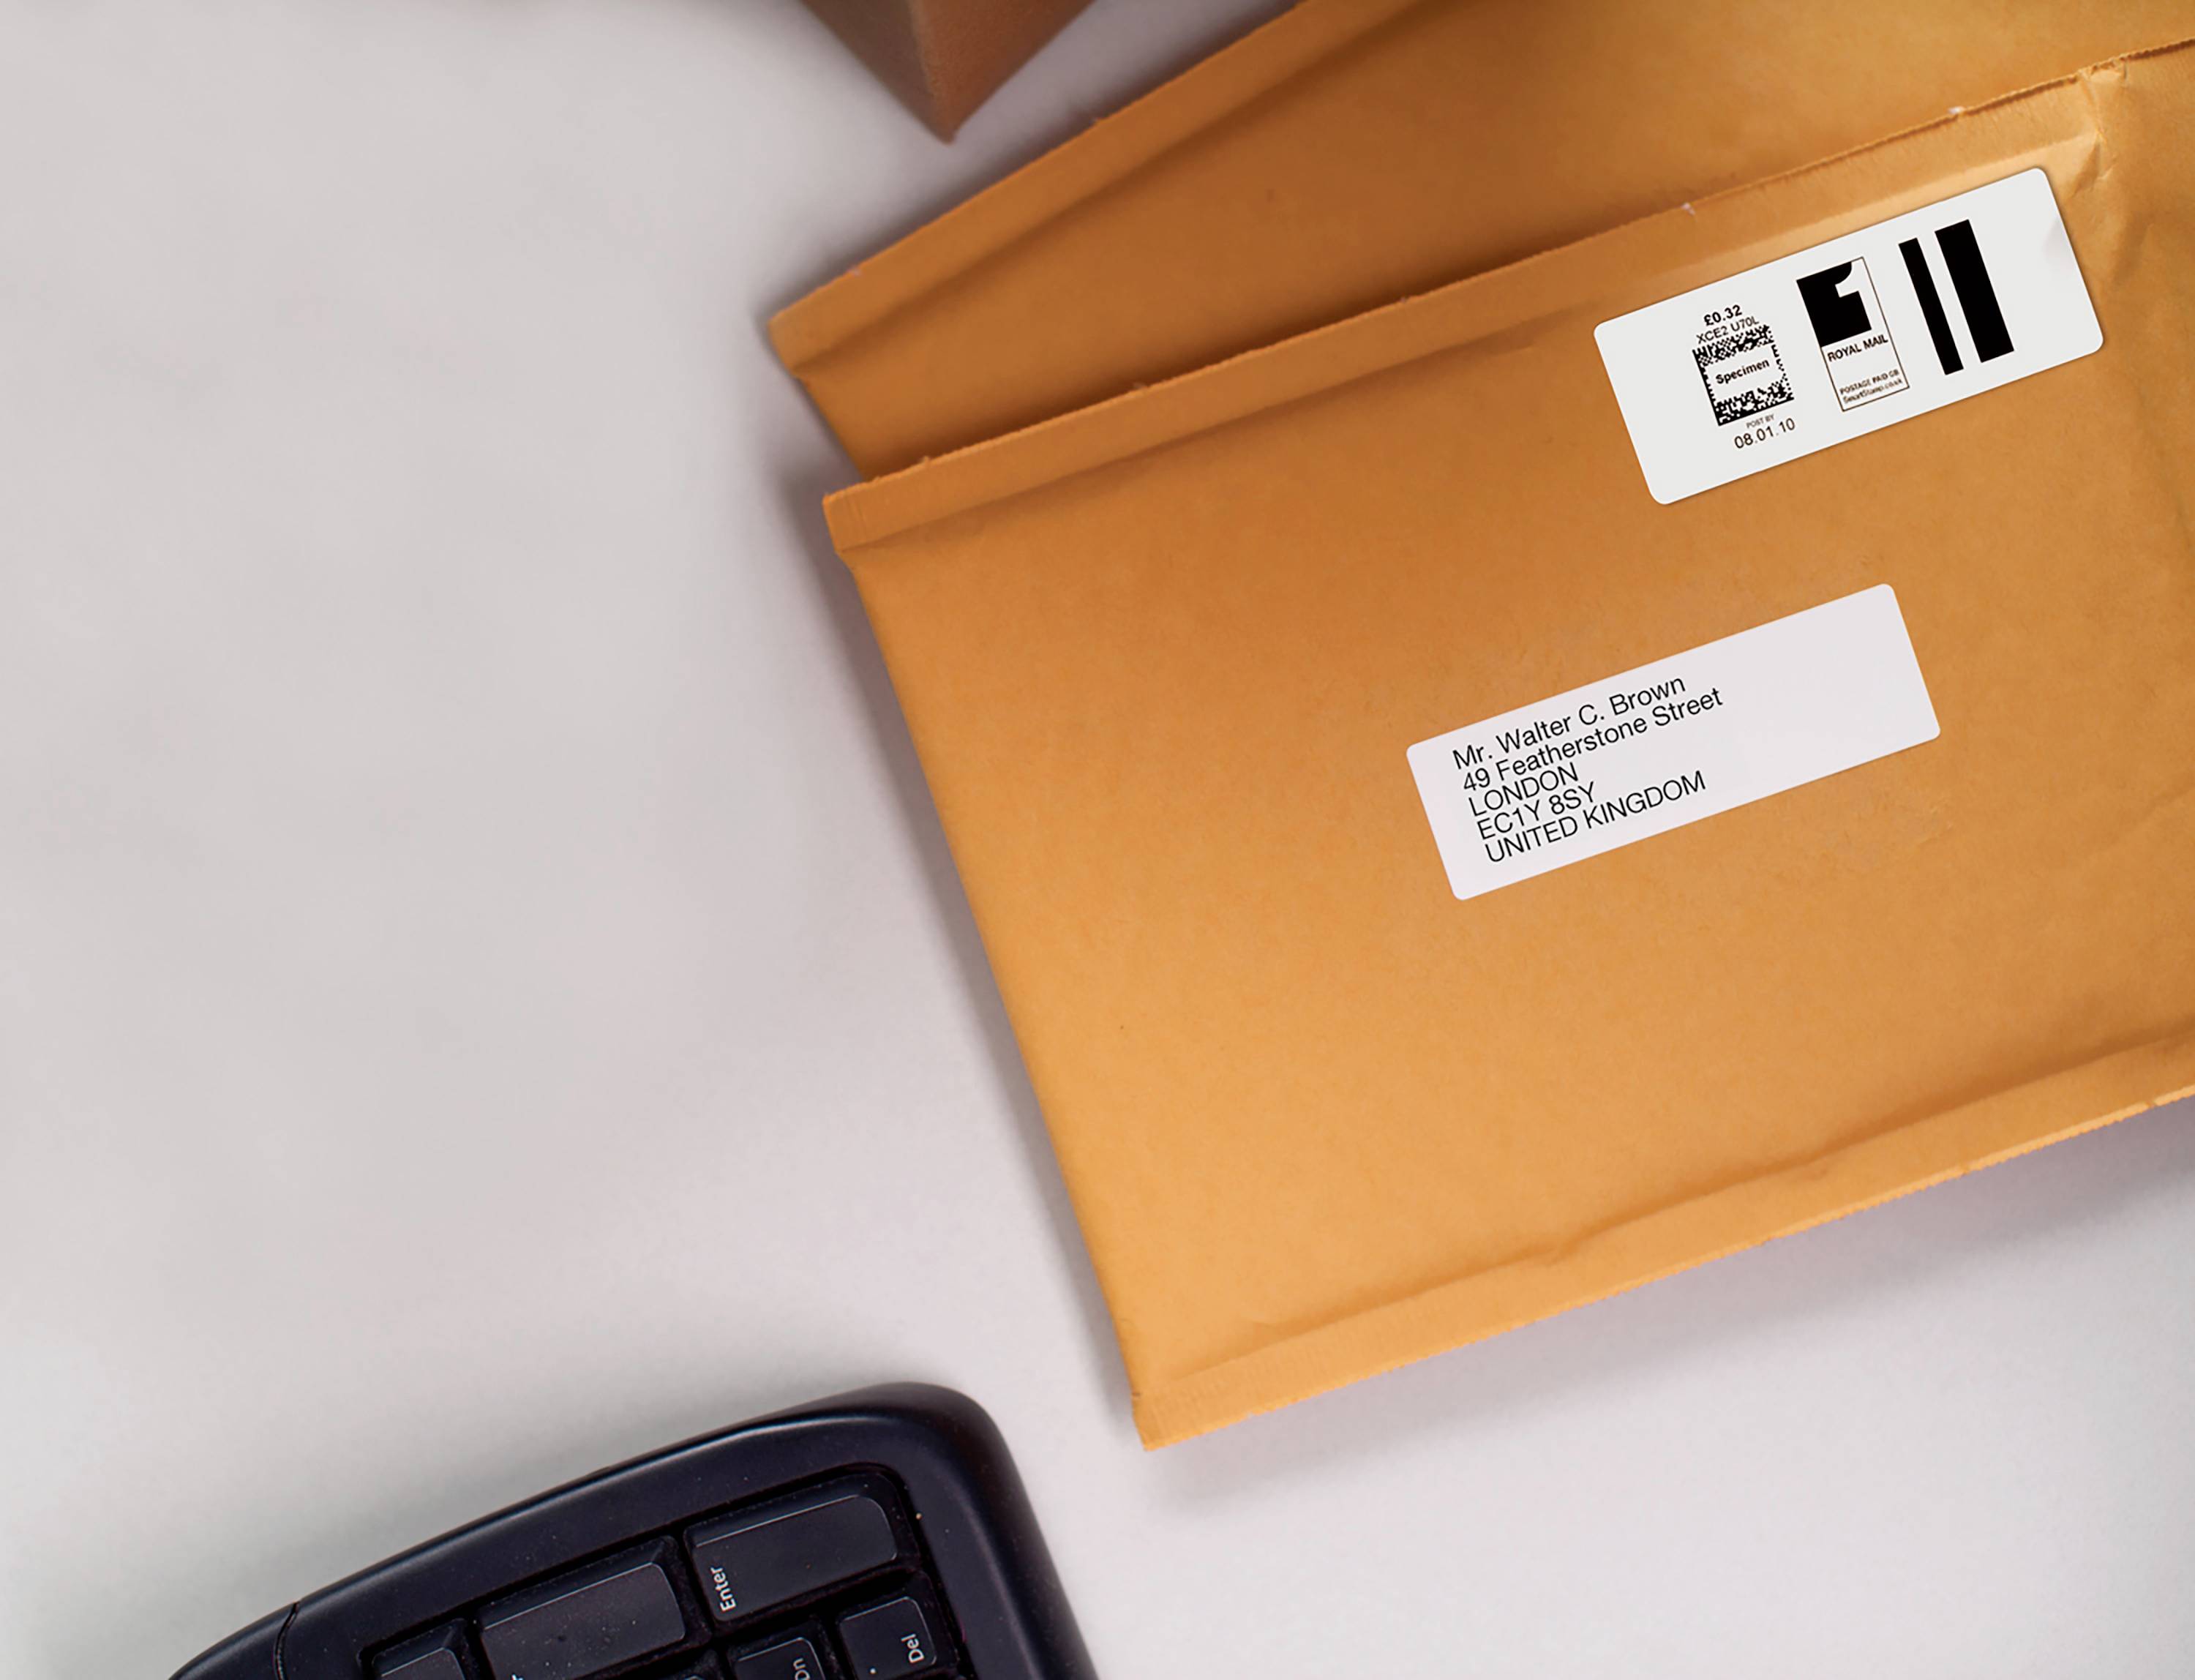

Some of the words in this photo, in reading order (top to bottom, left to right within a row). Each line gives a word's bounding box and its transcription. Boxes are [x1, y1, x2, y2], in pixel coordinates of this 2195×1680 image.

[1704, 304, 1742, 326] £0.32
[1697, 326, 1728, 344] XCE2
[1828, 344, 1861, 361] ROYAL
[1863, 334, 1888, 349] MAIL
[1716, 360, 1769, 384] Specimen
[1840, 378, 1870, 394] POSTAGE
[1872, 373, 1888, 383] PAID
[1888, 369, 1899, 378] GB
[1735, 418, 1795, 449] 08.01.10
[1746, 417, 1764, 429] POST
[1765, 414, 1775, 422] BY
[1453, 745, 1492, 769] Mr.
[1496, 716, 1570, 753] Walter
[1579, 705, 1604, 725] C.
[1610, 678, 1685, 715] Brown
[1464, 768, 1490, 790] 49
[1496, 718, 1647, 781] Featherstone
[1652, 688, 1722, 726] Street
[1468, 762, 1578, 817] LONDON
[1477, 800, 1539, 839] EC1Y
[1549, 781, 1594, 814] 8SY
[1485, 817, 1577, 862] UNITED
[1583, 770, 1706, 828] KINGDOM
[711, 1568, 736, 1611] Enter
[901, 1634, 924, 1662] Del
